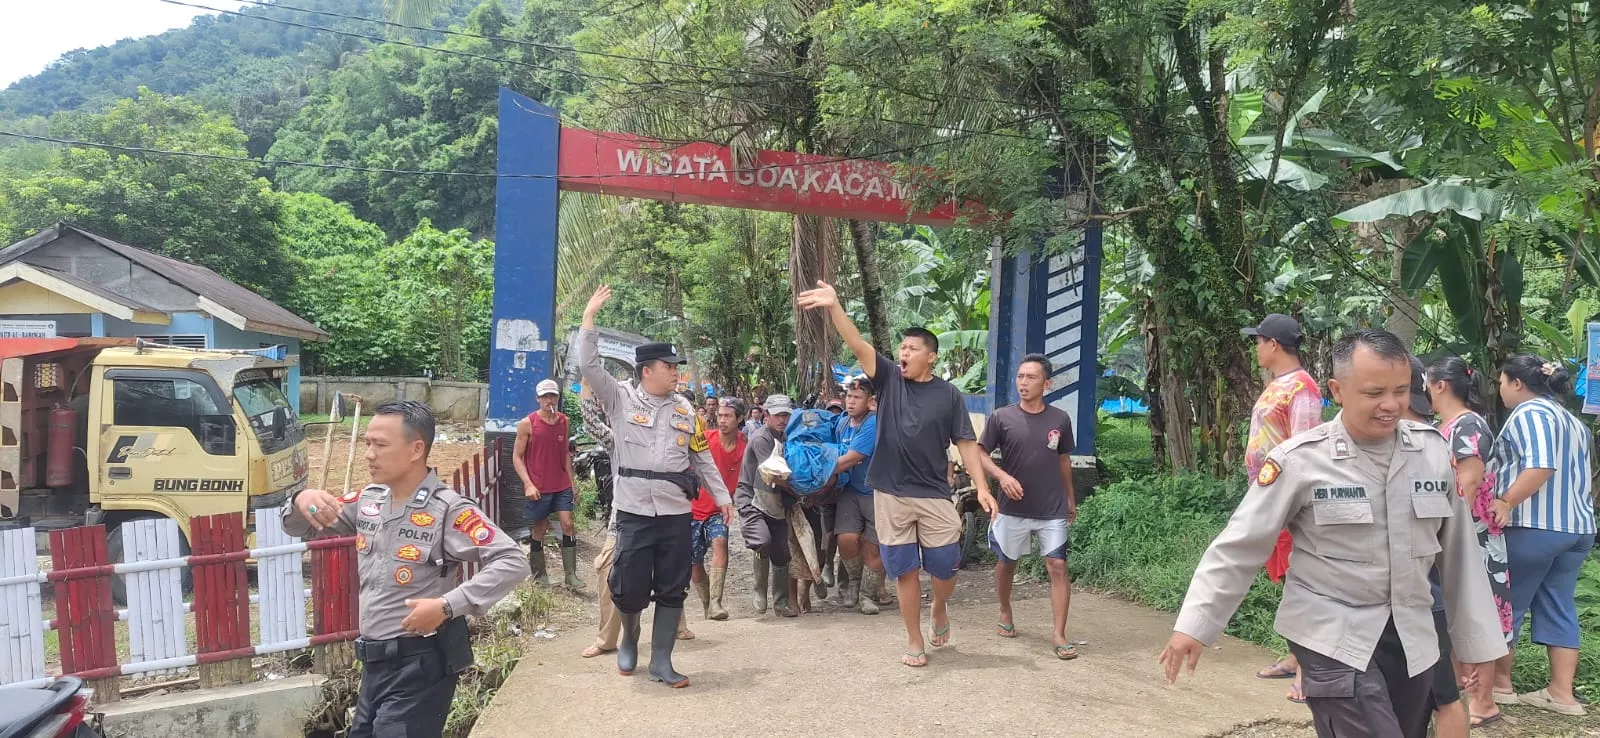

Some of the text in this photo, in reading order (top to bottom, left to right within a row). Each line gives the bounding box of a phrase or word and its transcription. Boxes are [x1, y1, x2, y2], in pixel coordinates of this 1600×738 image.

[616, 148, 729, 184] WISATA
[735, 163, 797, 190] GOA
[800, 165, 885, 199] KACA
[153, 479, 198, 492] BUNG
[1313, 488, 1328, 499] HERI
[398, 528, 434, 543] POLRI
